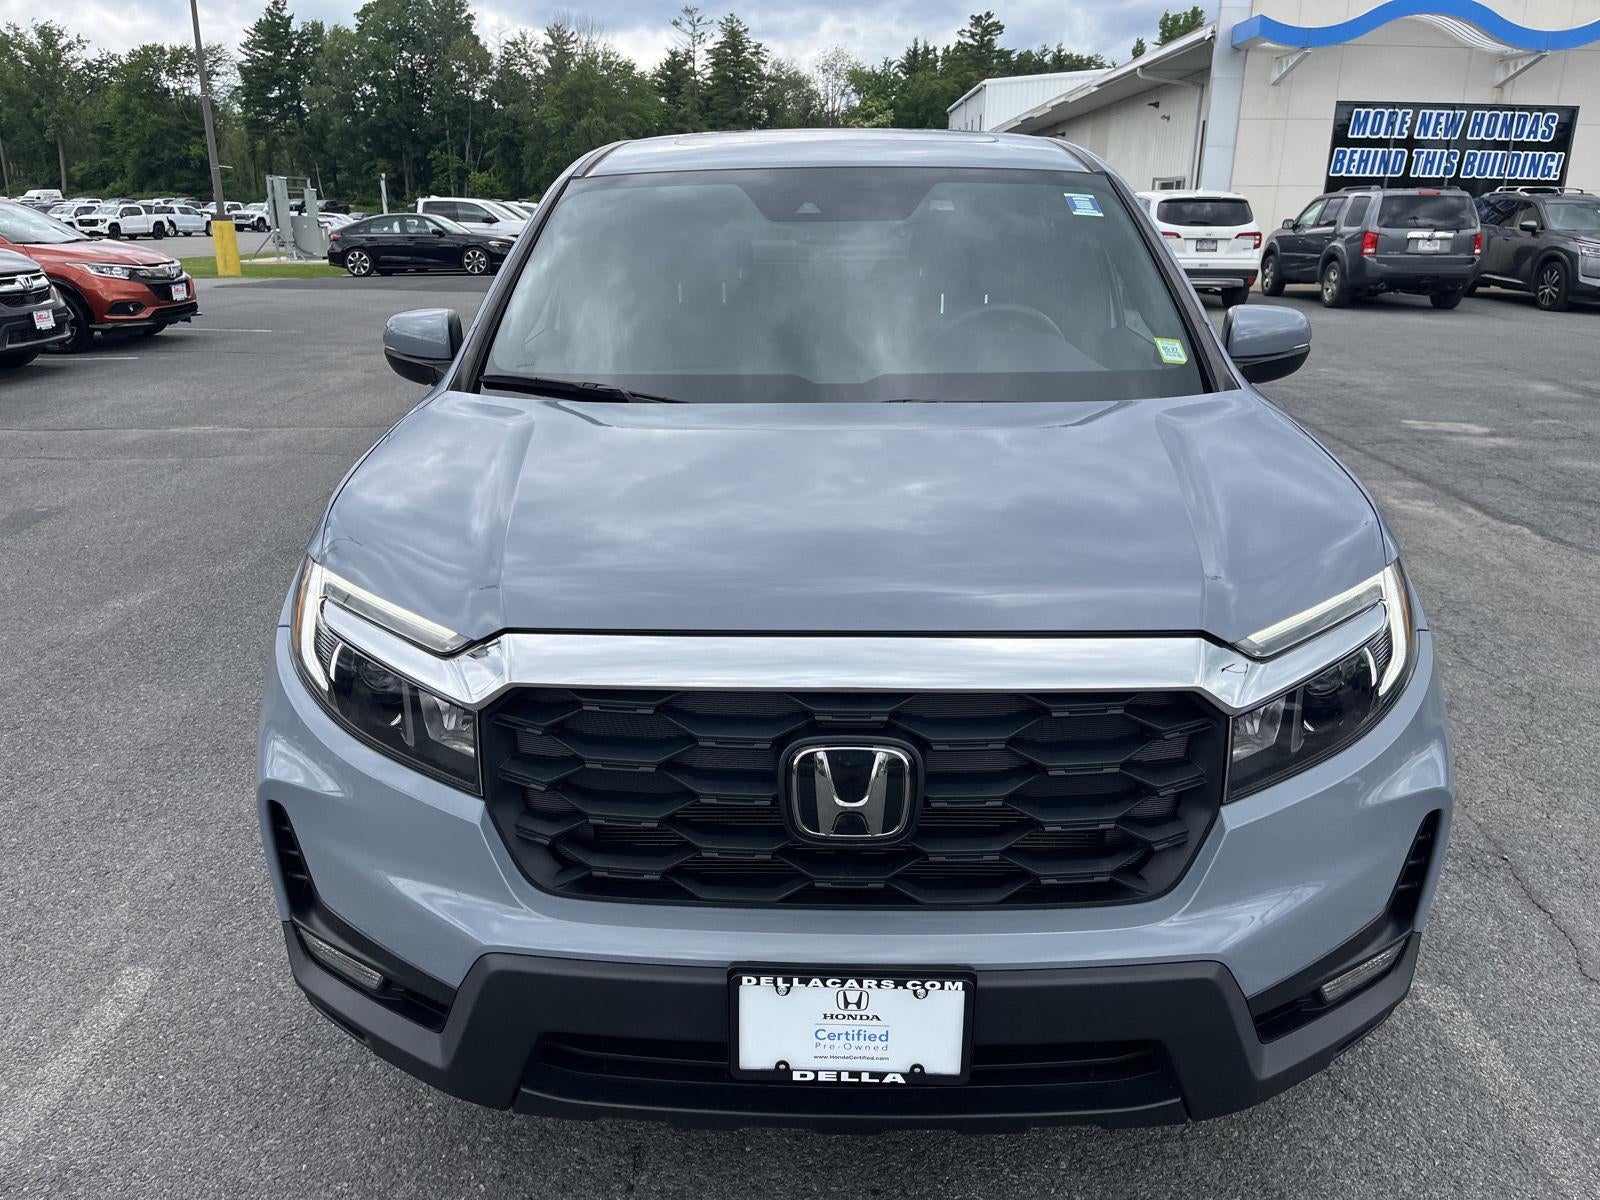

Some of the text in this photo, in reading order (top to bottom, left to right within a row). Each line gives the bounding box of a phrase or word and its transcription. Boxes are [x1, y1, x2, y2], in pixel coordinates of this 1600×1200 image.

[1348, 109, 1558, 142] MORE NEW HONDAS
[1330, 148, 1565, 181] BEHIND THIS BUILDING!
[741, 976, 963, 991] DELLACARS.COM
[822, 1013, 882, 1021] HONDA
[814, 1028, 889, 1042] Certified
[815, 1042, 888, 1052] Pre-Owned
[792, 1070, 906, 1084] DELLA
